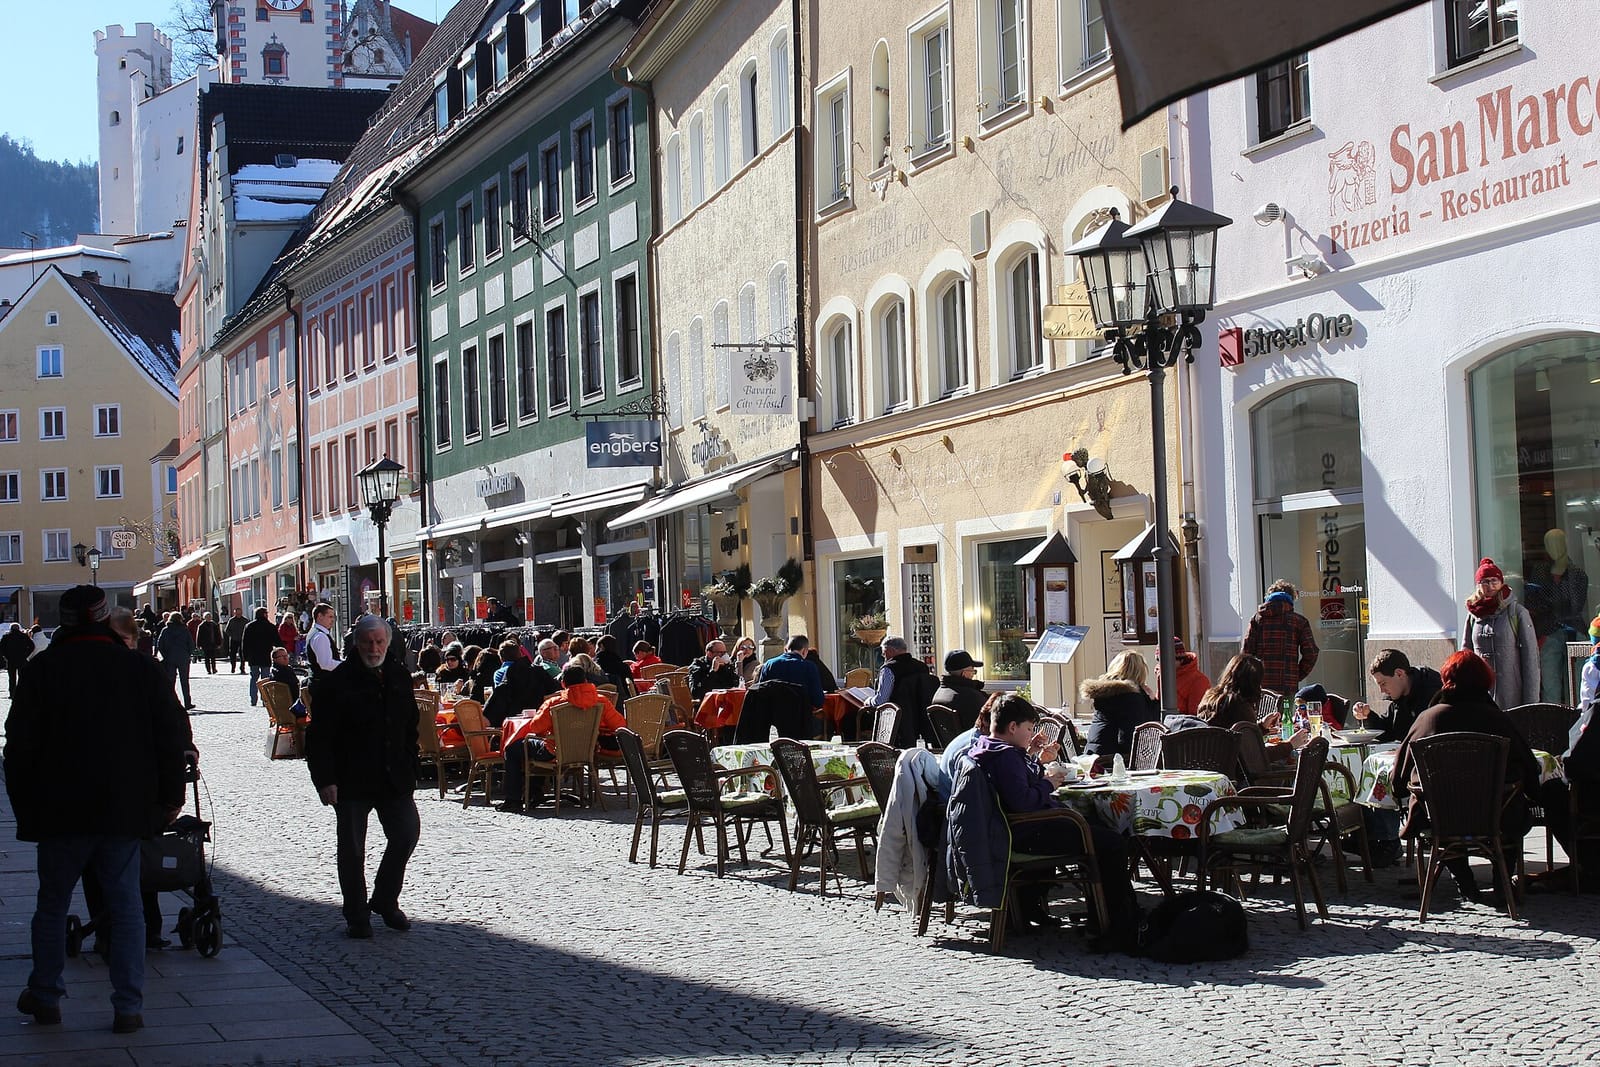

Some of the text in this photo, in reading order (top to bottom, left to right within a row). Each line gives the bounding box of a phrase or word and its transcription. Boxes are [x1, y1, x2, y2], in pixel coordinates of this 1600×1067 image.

[1390, 120, 1469, 194] San
[1330, 204, 1410, 254] Pizzeria
[1440, 153, 1570, 222] Restaurant
[743, 384, 777, 396] Bavaria
[736, 395, 787, 414] City Hostel
[590, 438, 659, 456] engbers
